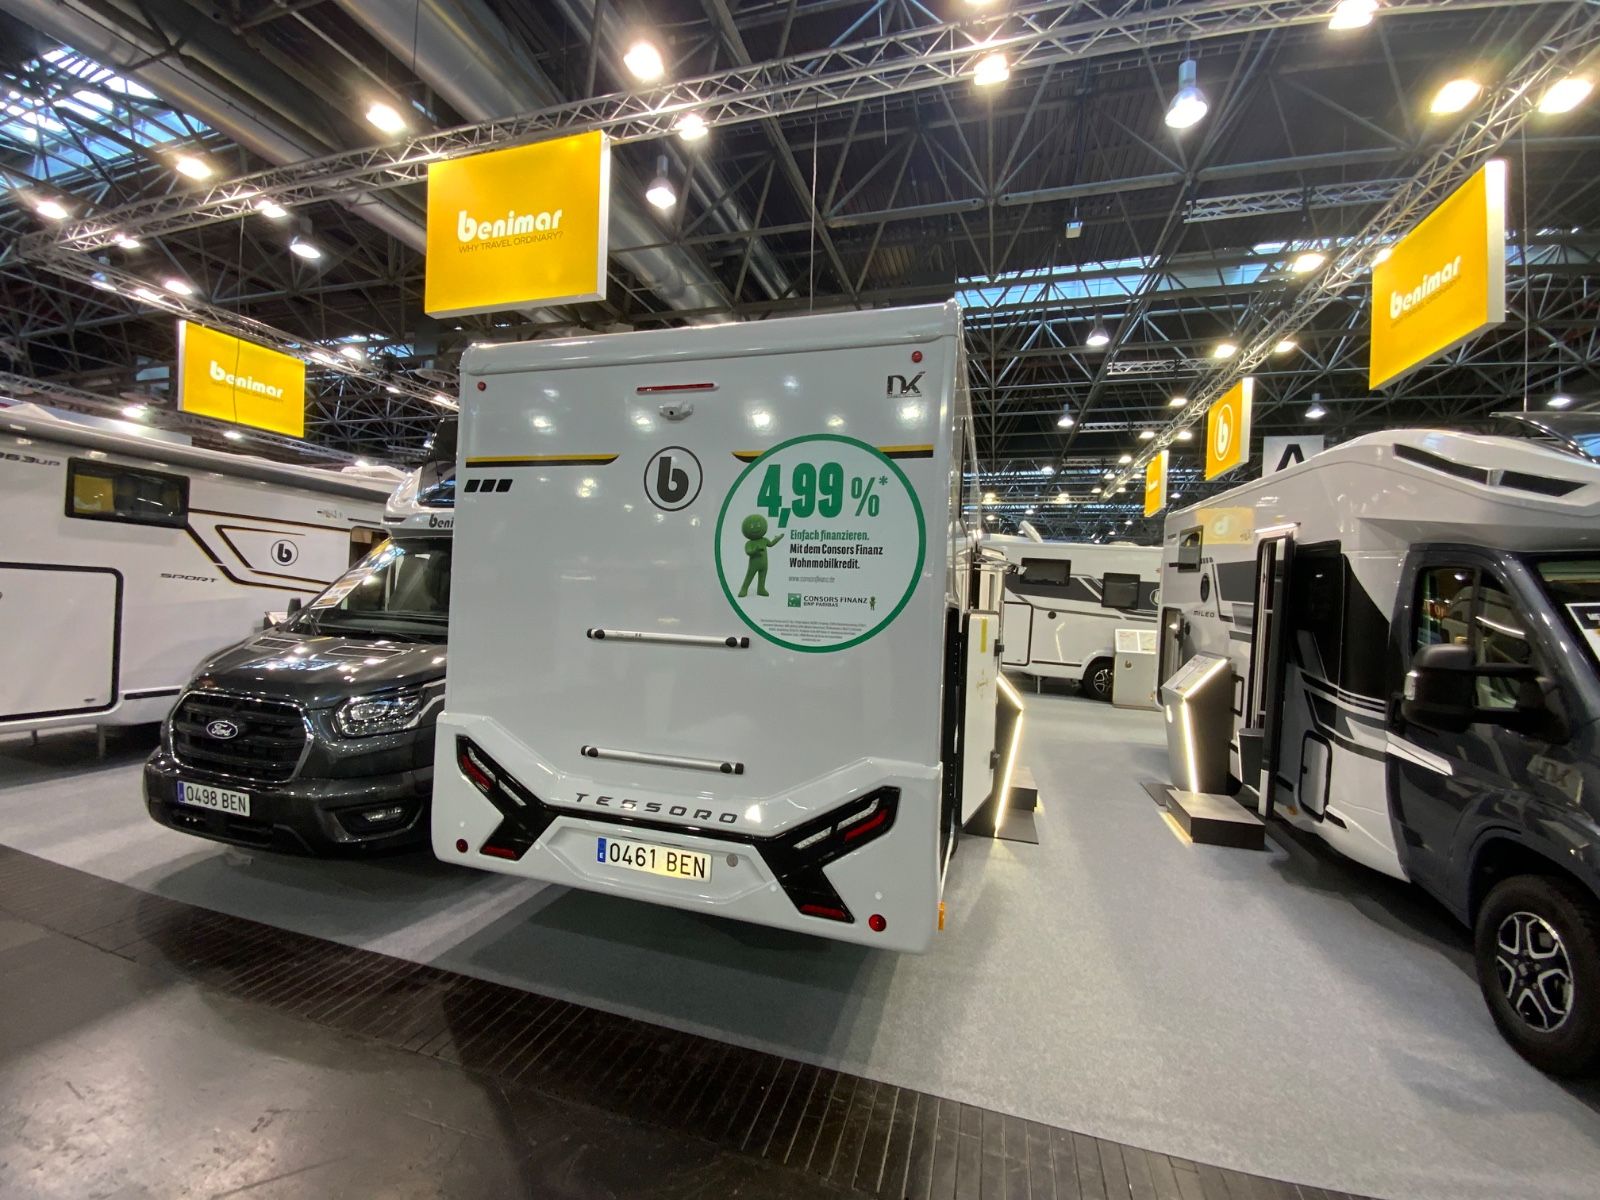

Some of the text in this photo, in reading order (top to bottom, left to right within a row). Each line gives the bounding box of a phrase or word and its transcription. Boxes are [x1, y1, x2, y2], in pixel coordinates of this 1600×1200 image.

[457, 209, 562, 243] benimar
[458, 231, 564, 254] WHY TRAVEL ORDINARY?
[1390, 255, 1461, 319] benimar
[210, 360, 283, 399] benimar
[656, 456, 689, 502] b
[757, 462, 844, 528] 4,99
[789, 543, 883, 555] Mit dem Consors Finanz
[790, 529, 870, 542] Einfach finanzieren.
[277, 543, 293, 563] b
[789, 557, 860, 569] Wohnmobilkredit.
[160, 572, 218, 583] SPORT
[803, 595, 868, 604] CONSORS FINANZ
[186, 786, 246, 813] 0498 BEN
[575, 792, 738, 824] TESSORO
[609, 842, 656, 868] 0461
[666, 852, 706, 878] BEN
